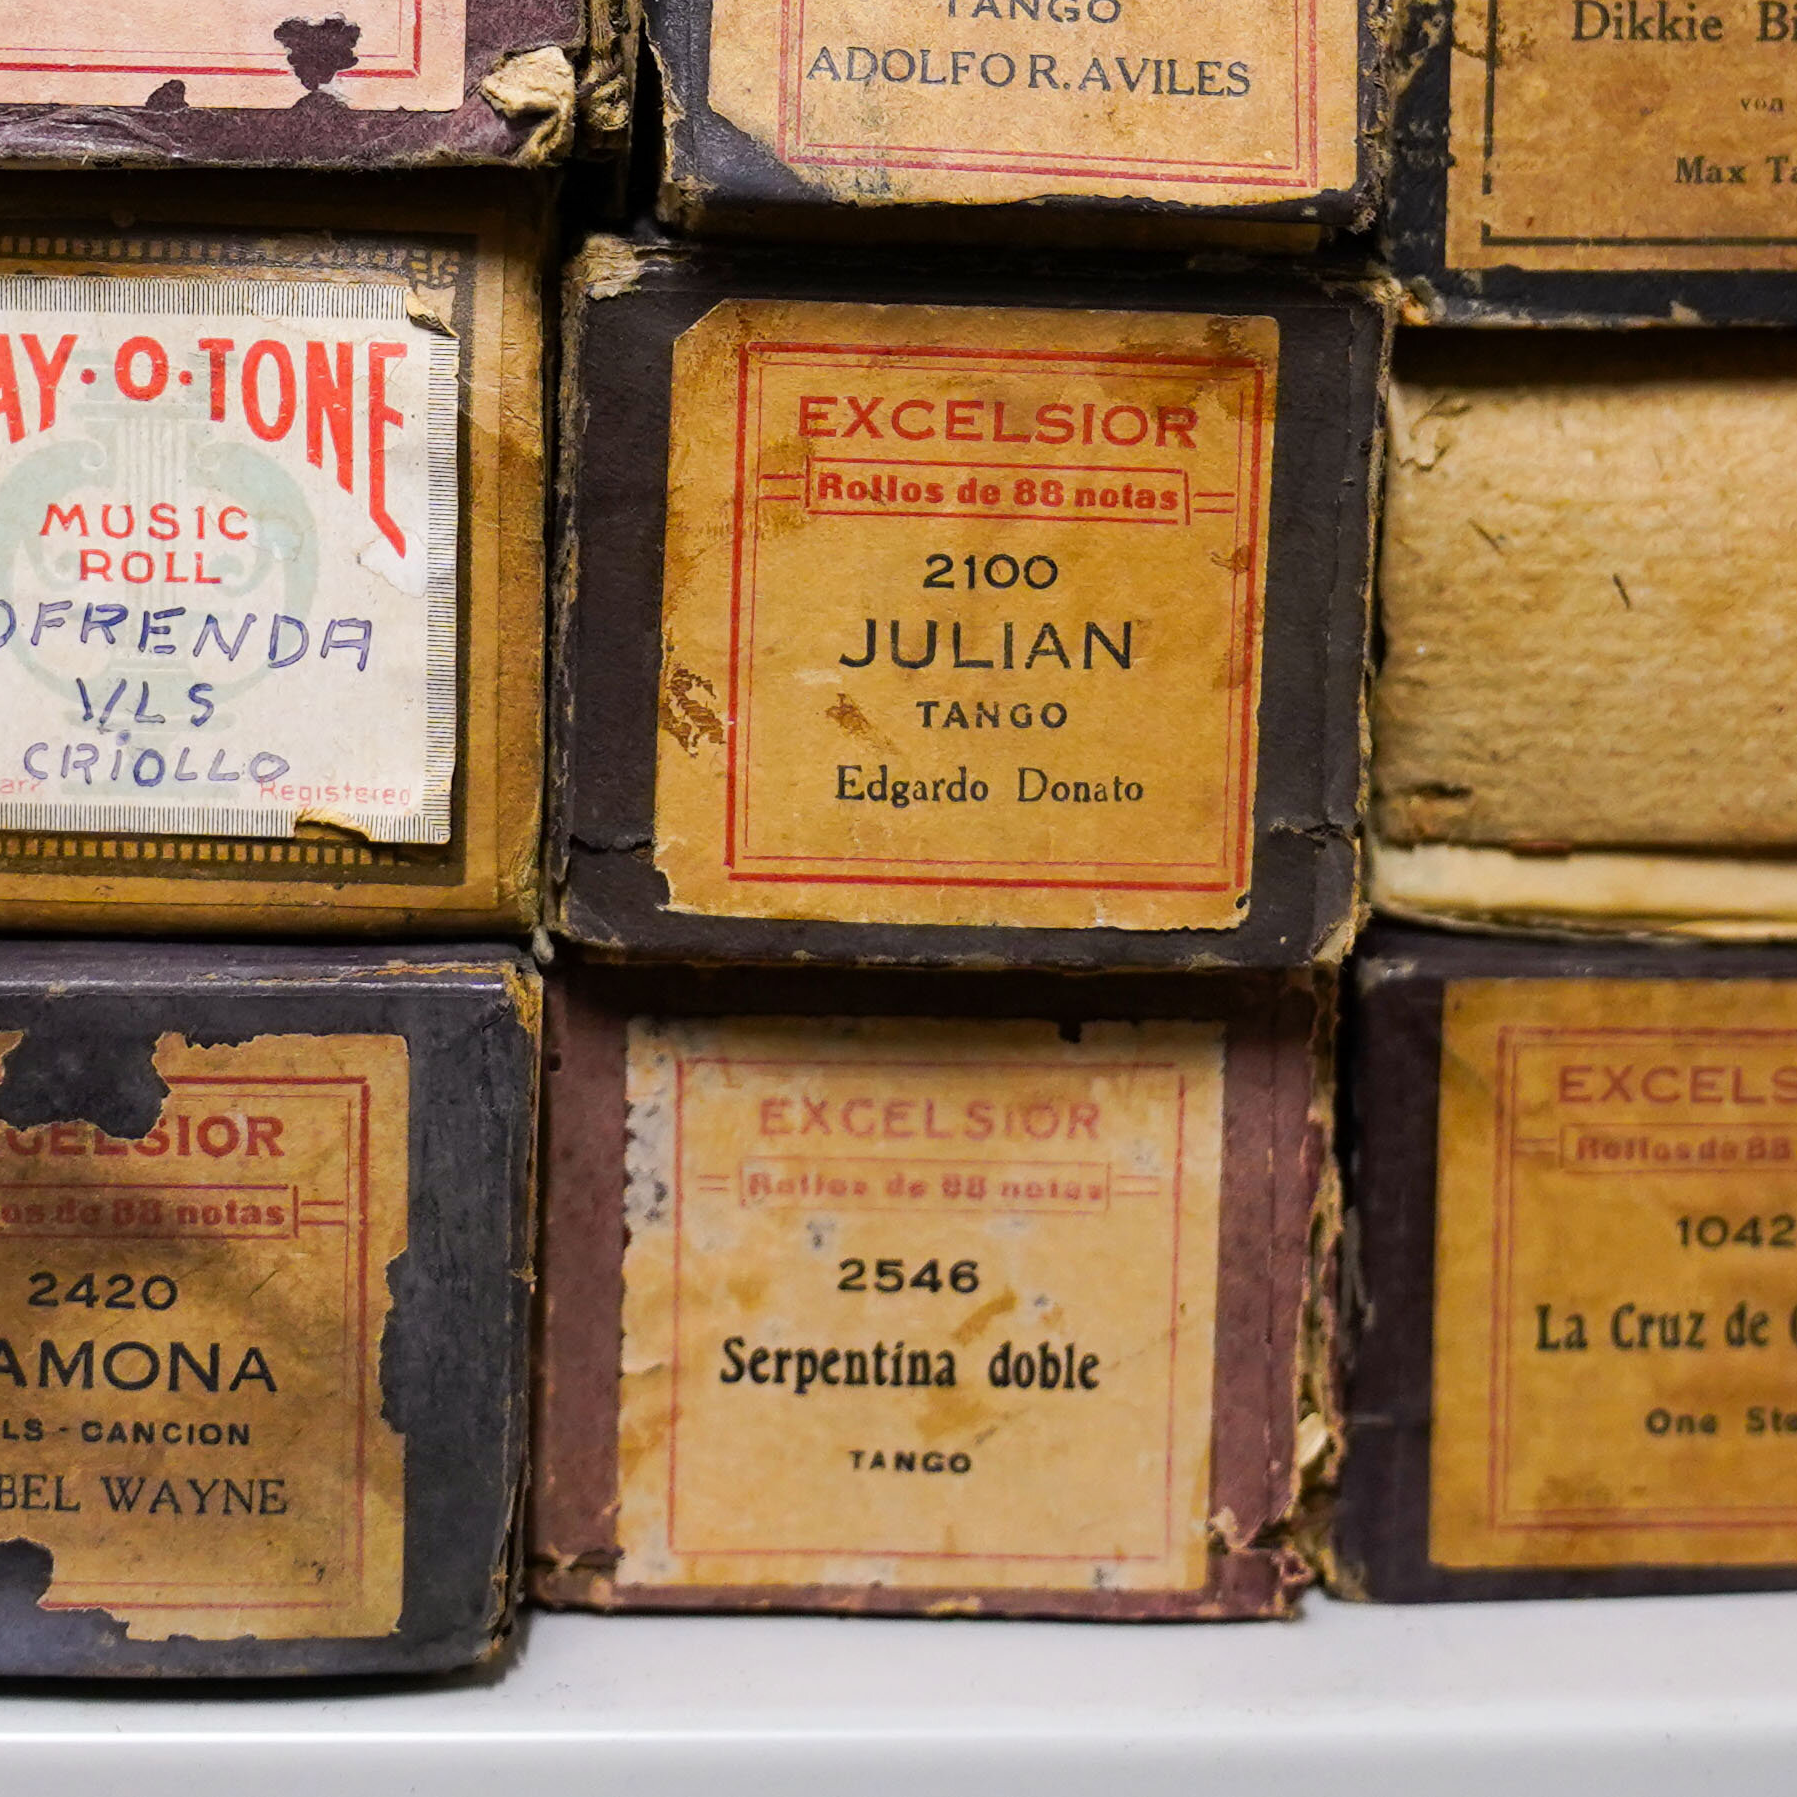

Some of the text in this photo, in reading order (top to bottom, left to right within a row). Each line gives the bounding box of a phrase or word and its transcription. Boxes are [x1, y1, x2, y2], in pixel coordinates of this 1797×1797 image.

[1571, 0, 1724, 42] Dikkie
[1675, 156, 1747, 183] Max
[800, 395, 1199, 449] EXCELSIOR
[40, 503, 248, 540] MUSIC
[80, 549, 221, 584] ROLL
[923, 554, 1059, 590] 2100
[839, 619, 1133, 670] JULIAN
[917, 701, 1068, 728] TANGO
[836, 764, 1144, 808] Edgardo Donato
[1677, 1214, 1797, 1248] 1042
[28, 1272, 178, 1310] 2420
[837, 1259, 980, 1293] 2546
[1536, 1304, 1588, 1350] La
[1610, 1304, 1705, 1349] Cruz
[1724, 1302, 1769, 1347] de
[720, 1337, 1100, 1394] Serpentina doble
[1645, 1408, 1717, 1436] One
[850, 1450, 972, 1474] TANGO
[101, 1477, 287, 1515] WAYNE
